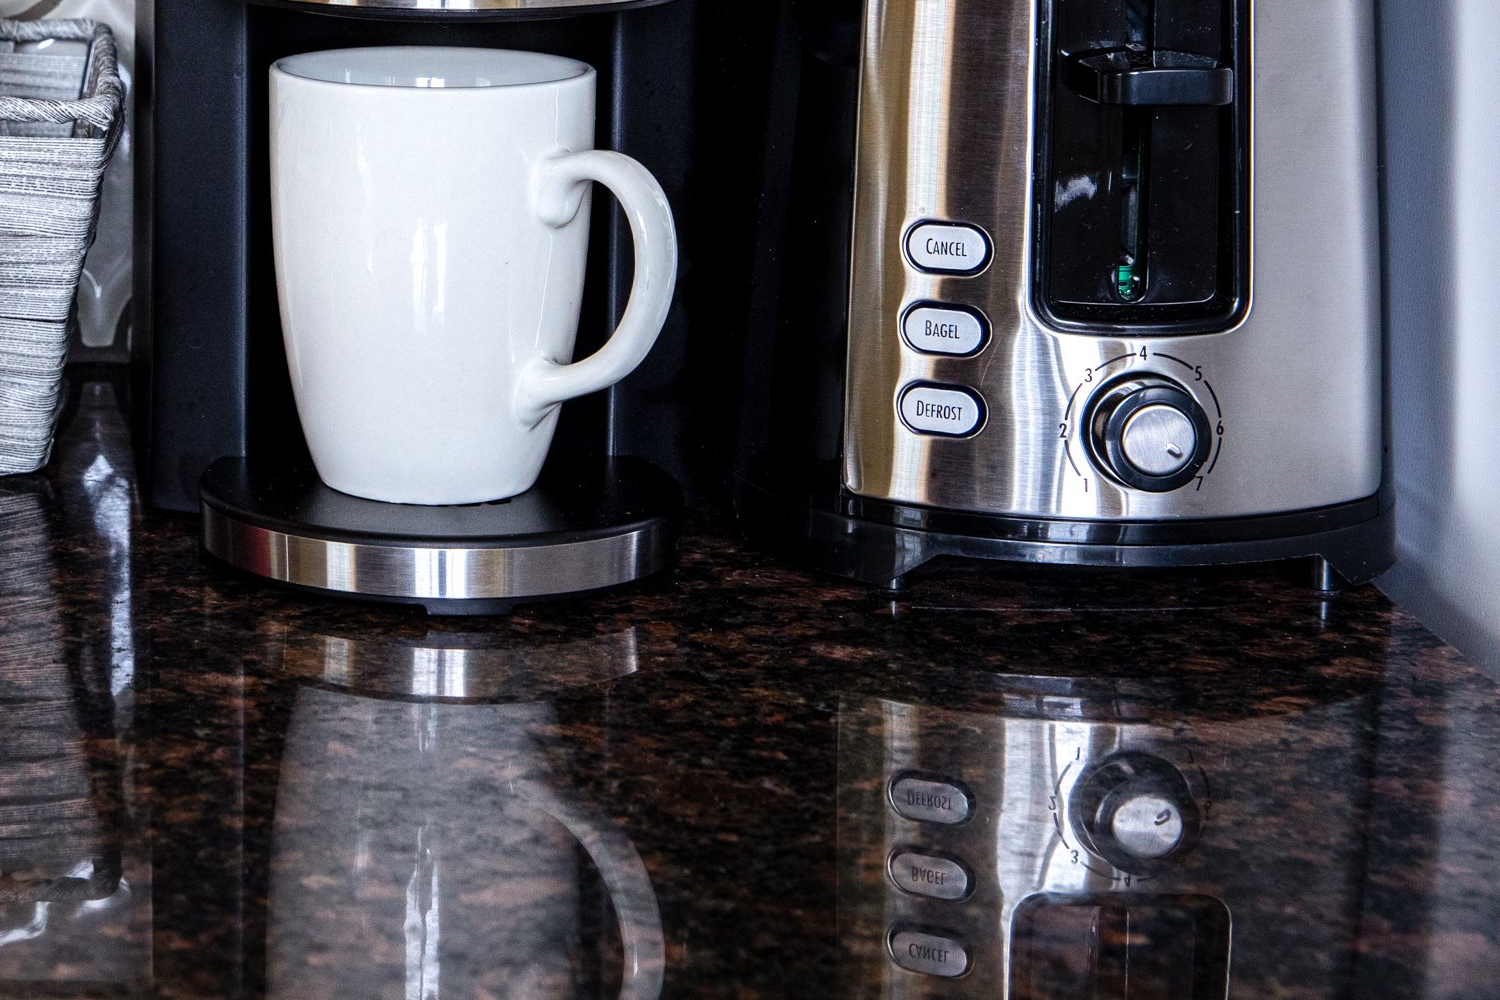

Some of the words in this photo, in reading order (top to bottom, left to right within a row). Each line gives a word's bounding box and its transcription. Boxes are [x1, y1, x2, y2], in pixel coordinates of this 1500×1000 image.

[926, 238, 968, 257] CANCEL
[924, 320, 960, 339] BAGEL
[1139, 345, 1148, 361] 4
[1084, 368, 1093, 383] 3
[1194, 366, 1203, 382] 5
[916, 400, 963, 421] DEFROST
[1059, 423, 1067, 438] 2
[1216, 420, 1224, 435] 6
[1083, 478, 1088, 492] 1
[1195, 475, 1204, 491] 7
